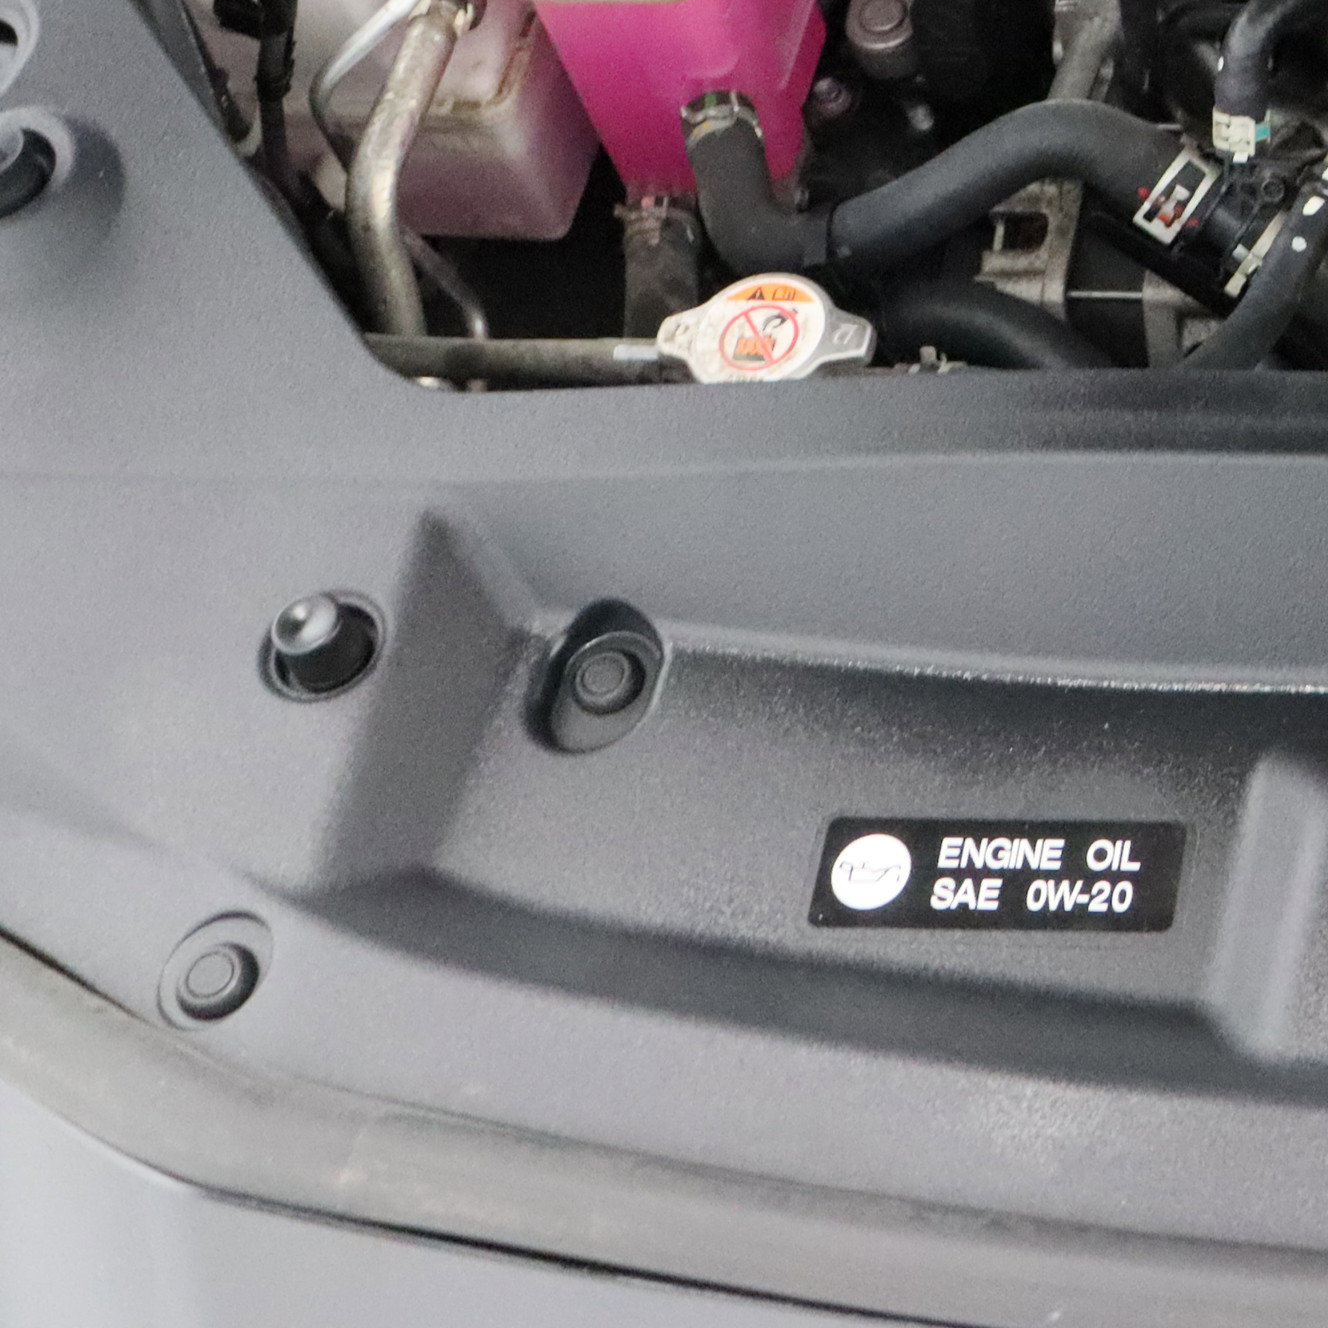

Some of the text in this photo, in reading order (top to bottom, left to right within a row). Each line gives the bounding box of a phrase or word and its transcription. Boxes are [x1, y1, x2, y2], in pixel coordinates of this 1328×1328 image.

[937, 837, 1142, 871] ENGINE OIL
[930, 878, 1134, 912] SAE 0W-20
